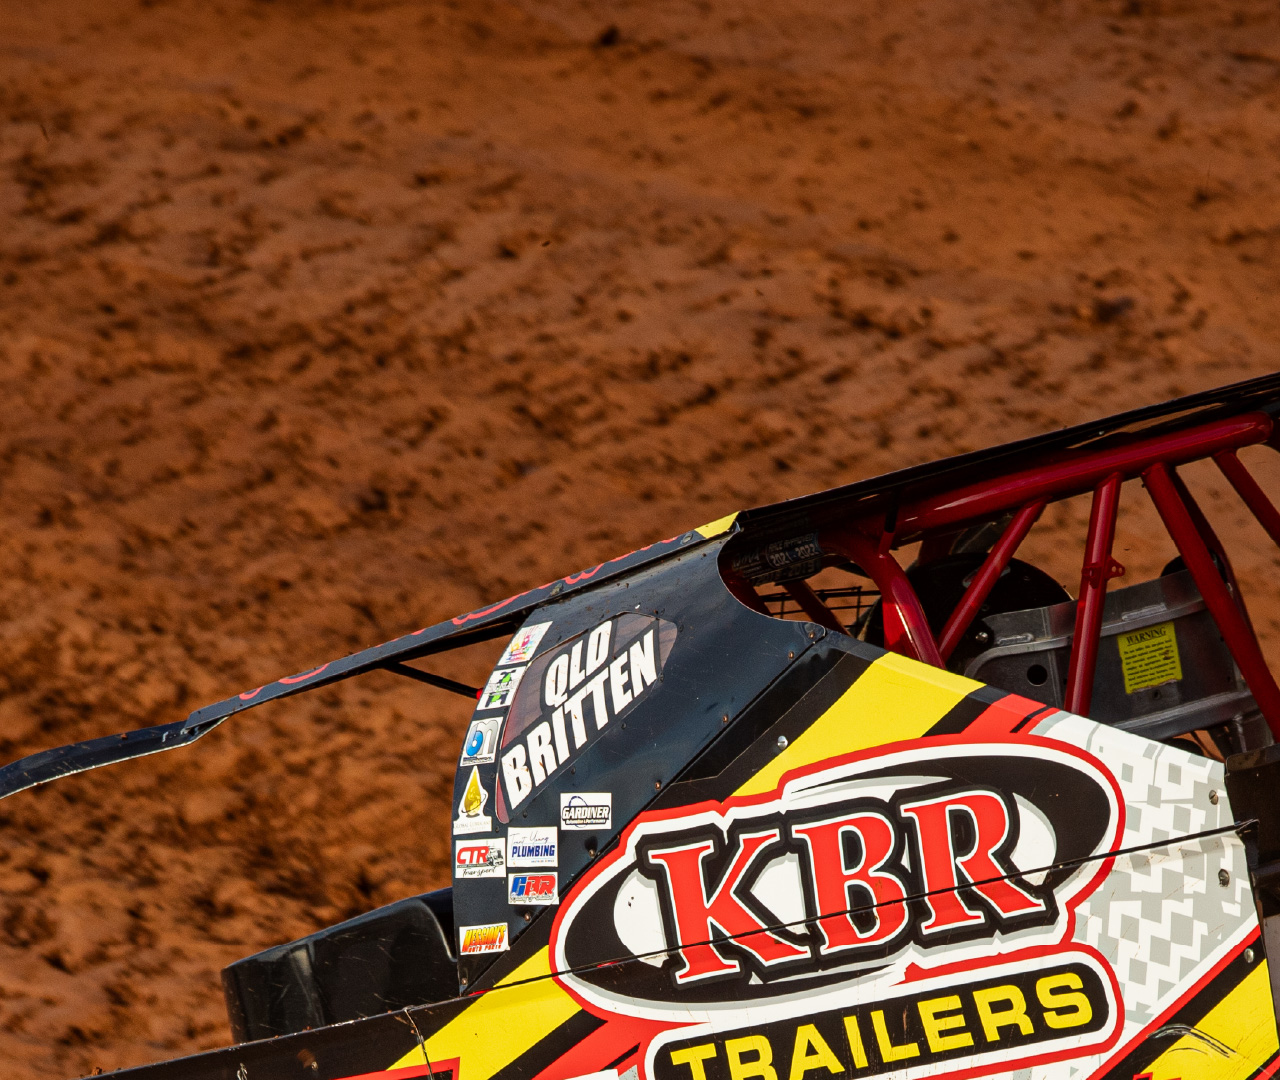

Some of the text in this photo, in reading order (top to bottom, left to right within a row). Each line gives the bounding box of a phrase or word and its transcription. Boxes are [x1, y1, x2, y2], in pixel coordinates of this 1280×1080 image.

[1126, 626, 1167, 645] WARNING
[545, 619, 614, 708] QLD
[501, 629, 658, 810] BRITTEN
[562, 806, 610, 819] GARDINER
[457, 846, 489, 864] CTR
[512, 845, 555, 858] PLUMBING
[649, 790, 1046, 985] KBR
